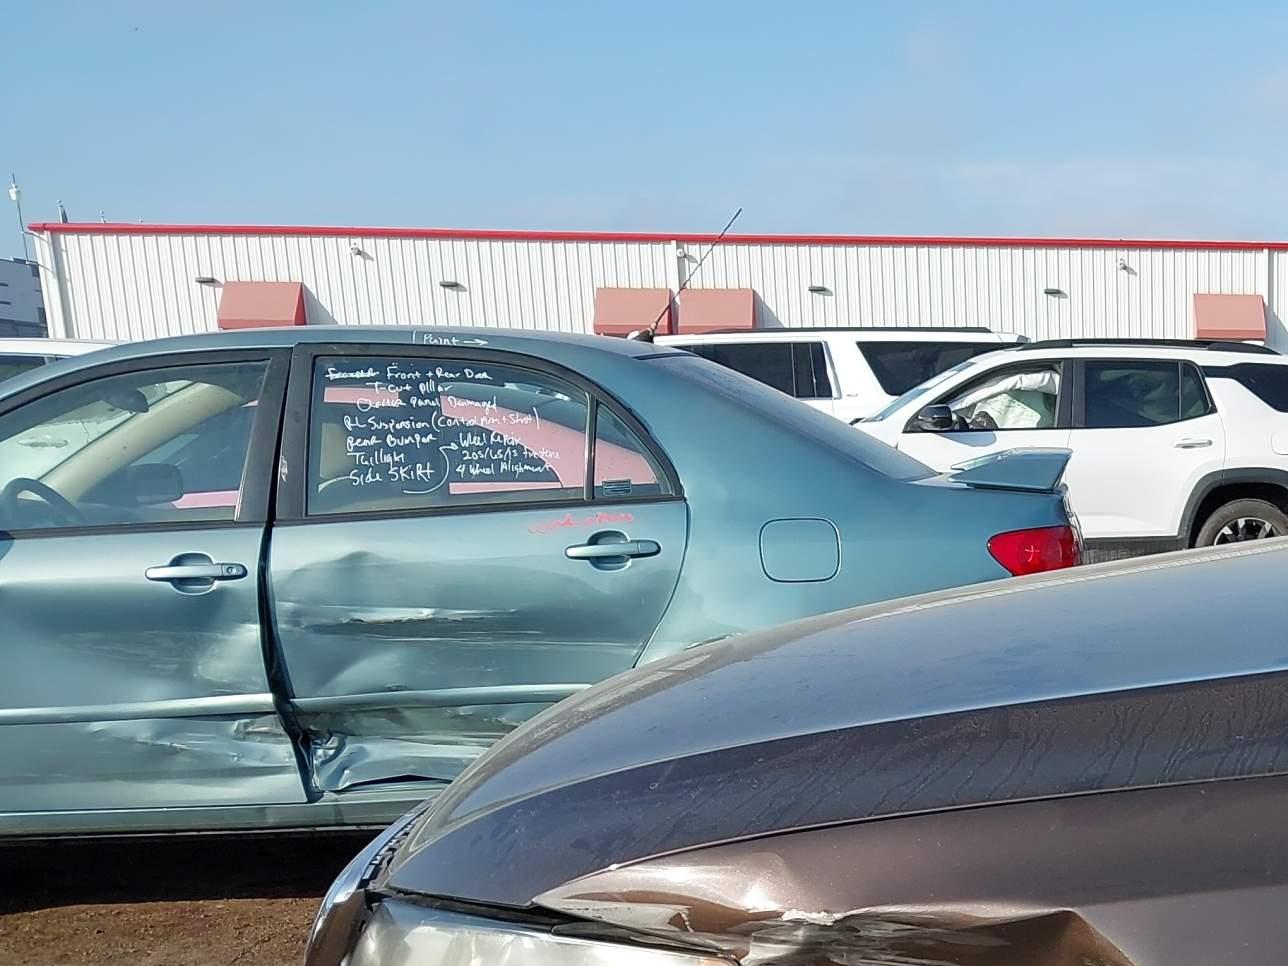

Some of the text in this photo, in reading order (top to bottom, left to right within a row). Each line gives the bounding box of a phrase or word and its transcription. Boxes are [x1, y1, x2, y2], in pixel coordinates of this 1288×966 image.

[387, 365, 421, 380] Front
[410, 397, 441, 410] Panel
[368, 416, 430, 433] Suspension
